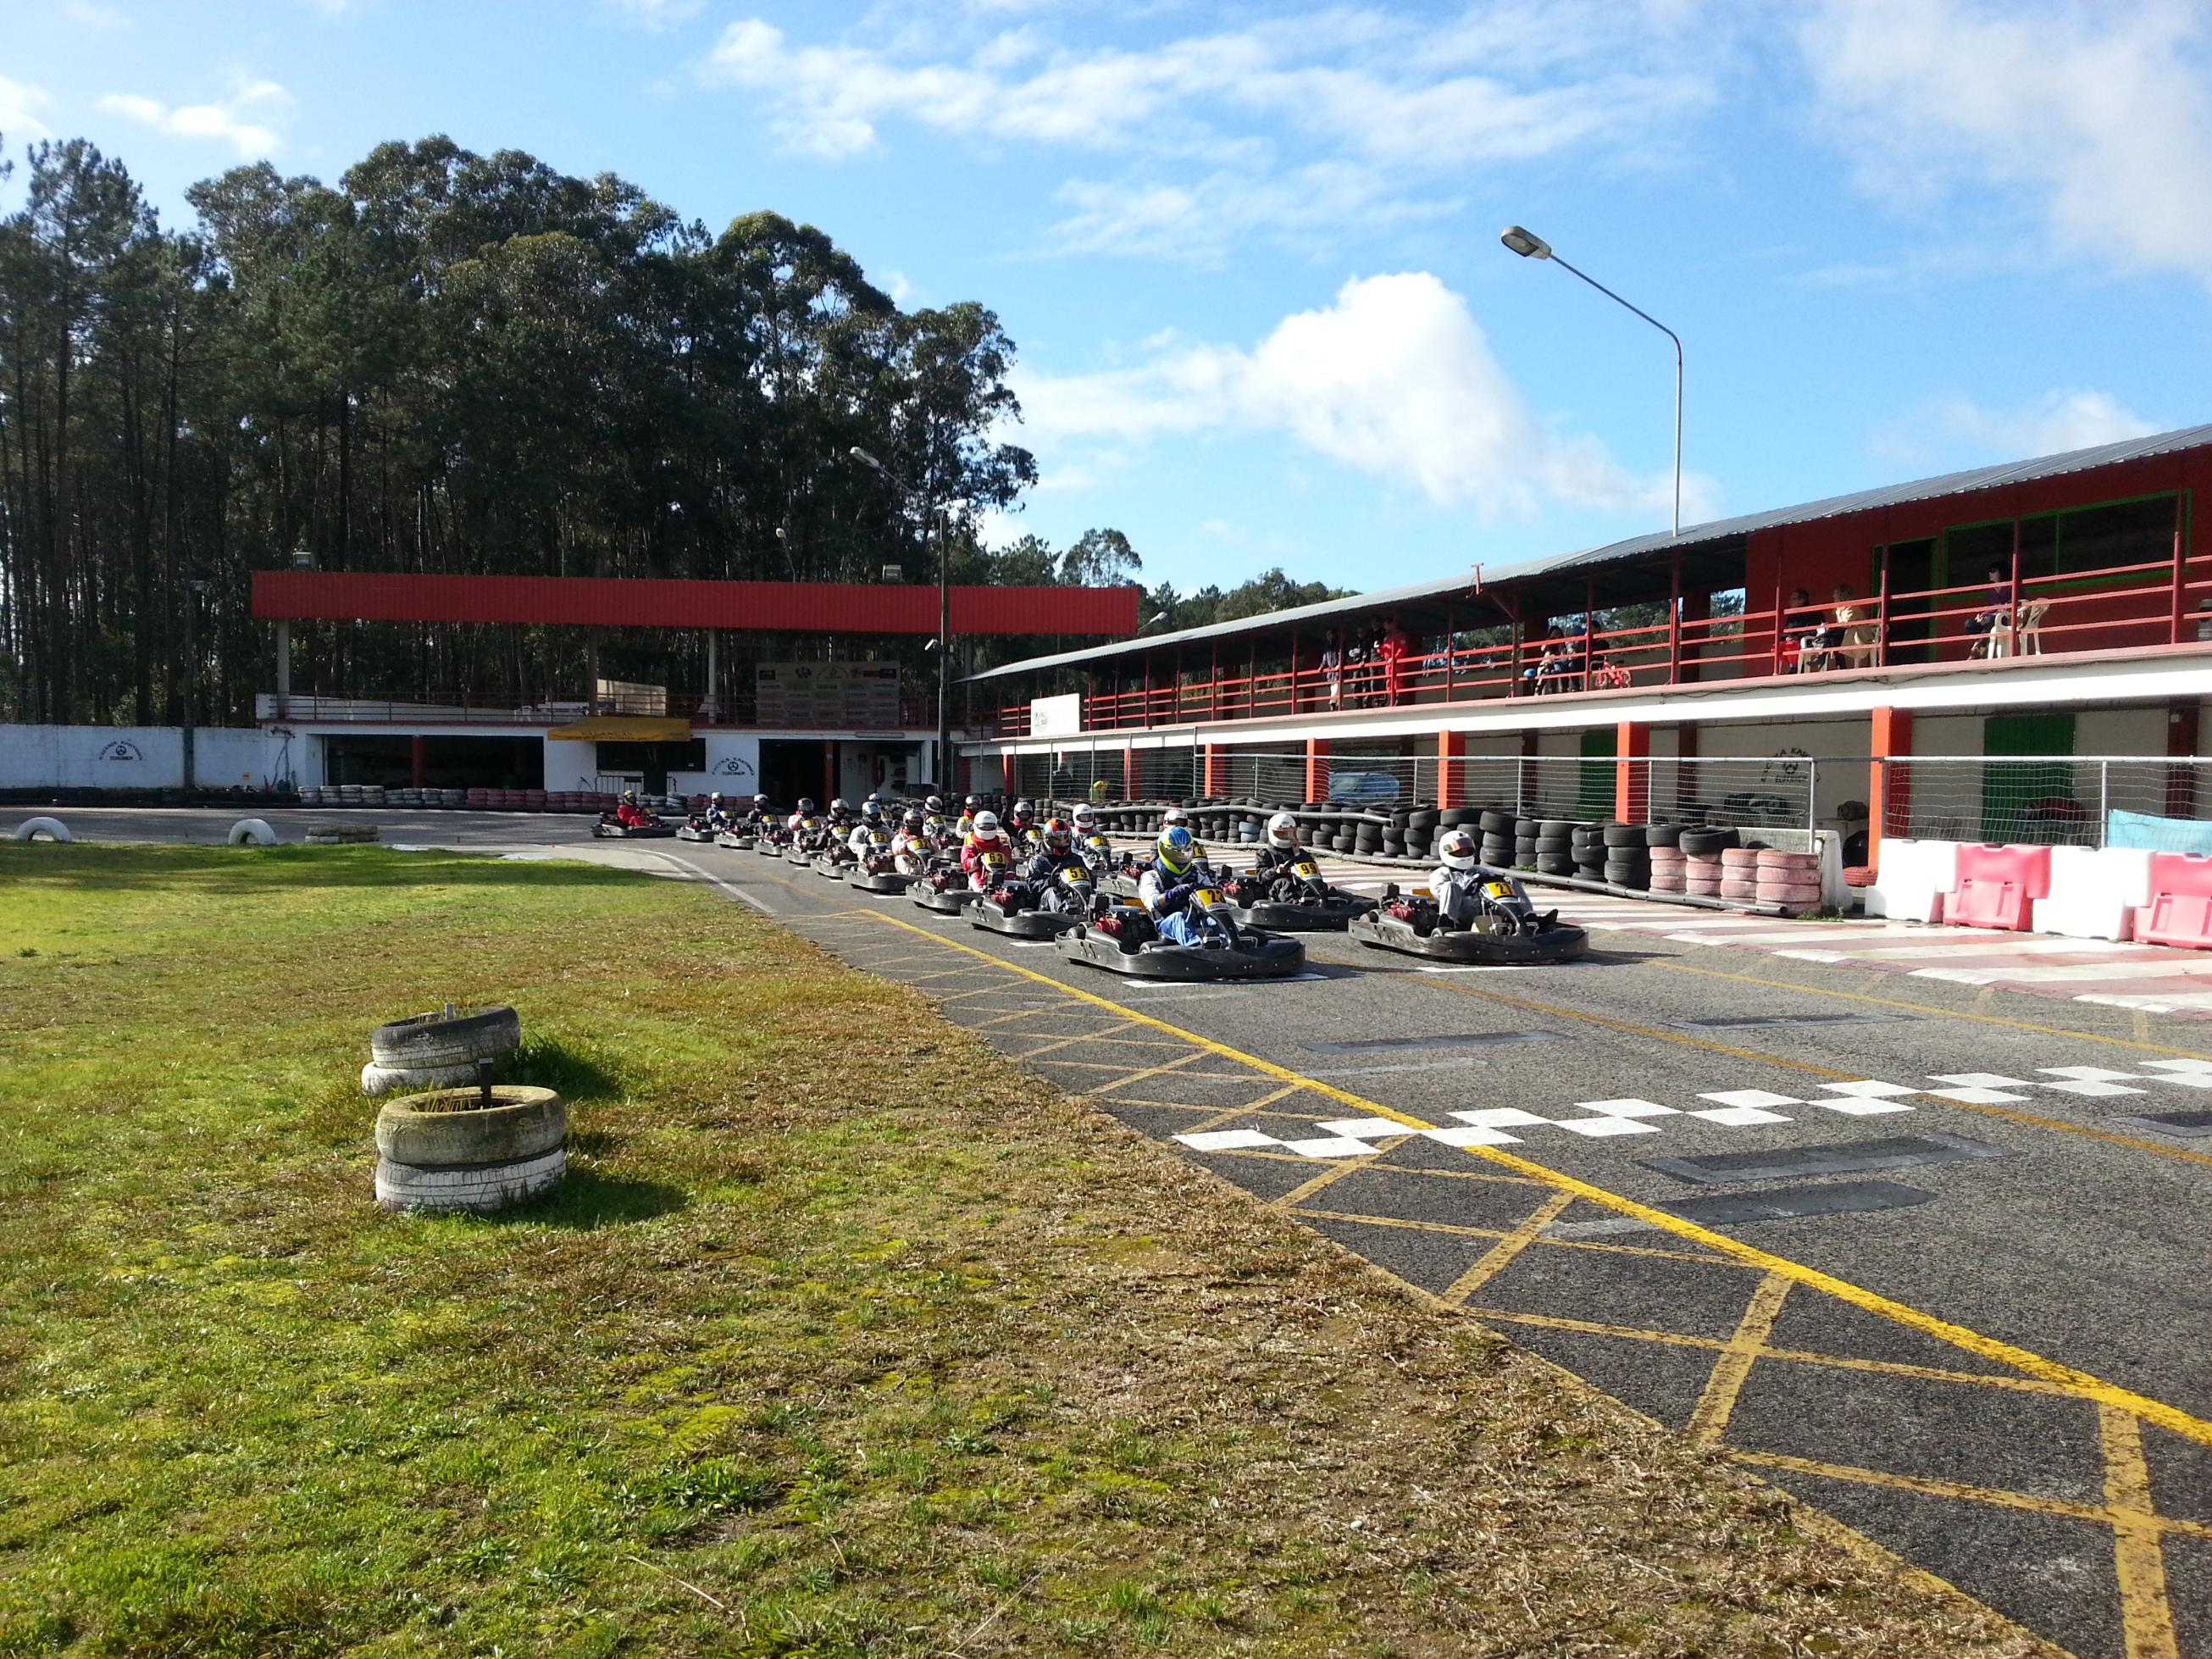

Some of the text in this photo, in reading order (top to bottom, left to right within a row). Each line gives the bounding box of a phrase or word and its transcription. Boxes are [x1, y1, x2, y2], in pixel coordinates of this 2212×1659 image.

[989, 852, 1004, 863] 63
[1069, 868, 1088, 879] 55
[1300, 863, 1317, 874] 99
[1207, 890, 1227, 904] 23
